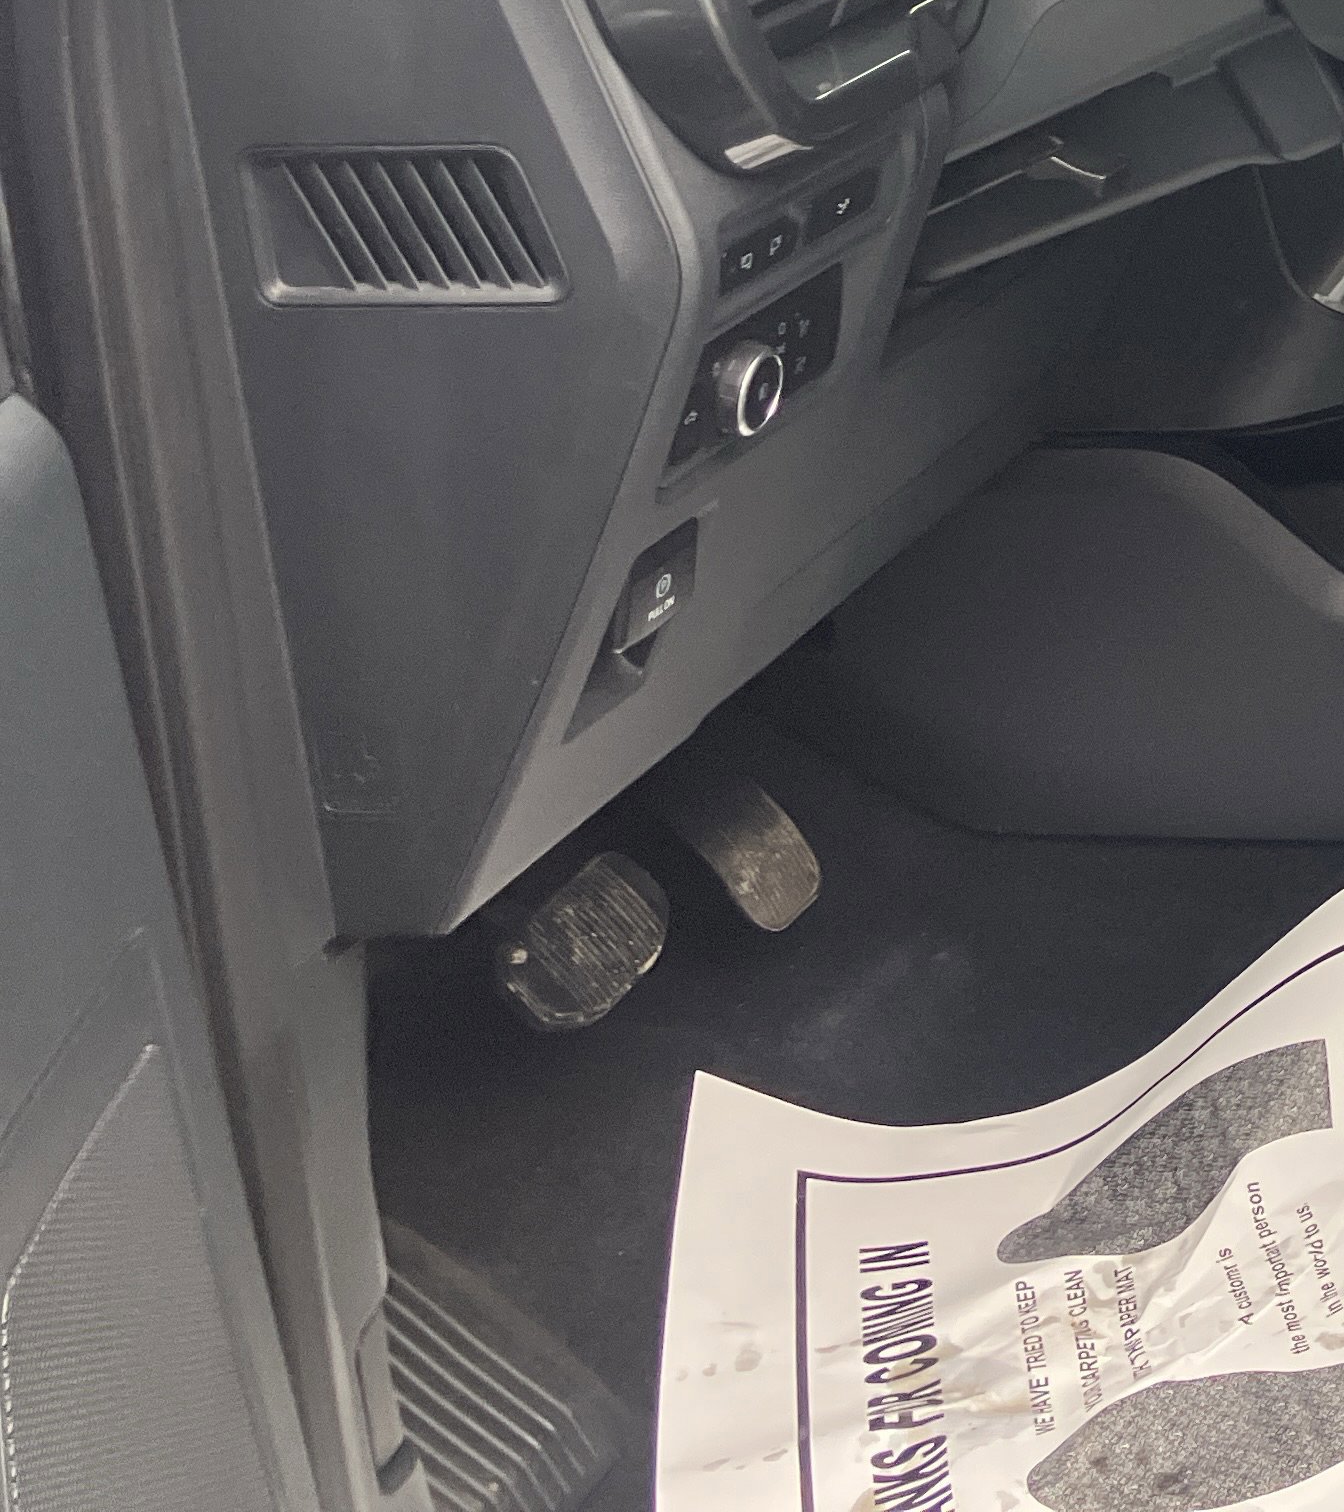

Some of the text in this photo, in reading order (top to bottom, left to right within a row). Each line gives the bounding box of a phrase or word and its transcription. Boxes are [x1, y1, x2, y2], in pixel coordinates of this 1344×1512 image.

[1247, 1181, 1278, 1239] person
[1303, 1223, 1320, 1240] to
[859, 1241, 930, 1273] IN
[1215, 1247, 1235, 1264] is
[1304, 1239, 1331, 1280] world
[1064, 1269, 1088, 1318] CLEAN
[1114, 1266, 1135, 1295] MAT
[1319, 1281, 1340, 1302] the
[1118, 1295, 1141, 1341] PAPER
[1238, 1312, 1255, 1326] A
[1275, 1299, 1302, 1332] most
[1325, 1300, 1344, 1318] in
[860, 1278, 940, 1383] COMING
[1290, 1333, 1311, 1355] the
[1015, 1280, 1056, 1436] WE HAVE TRIED TO KEEP
